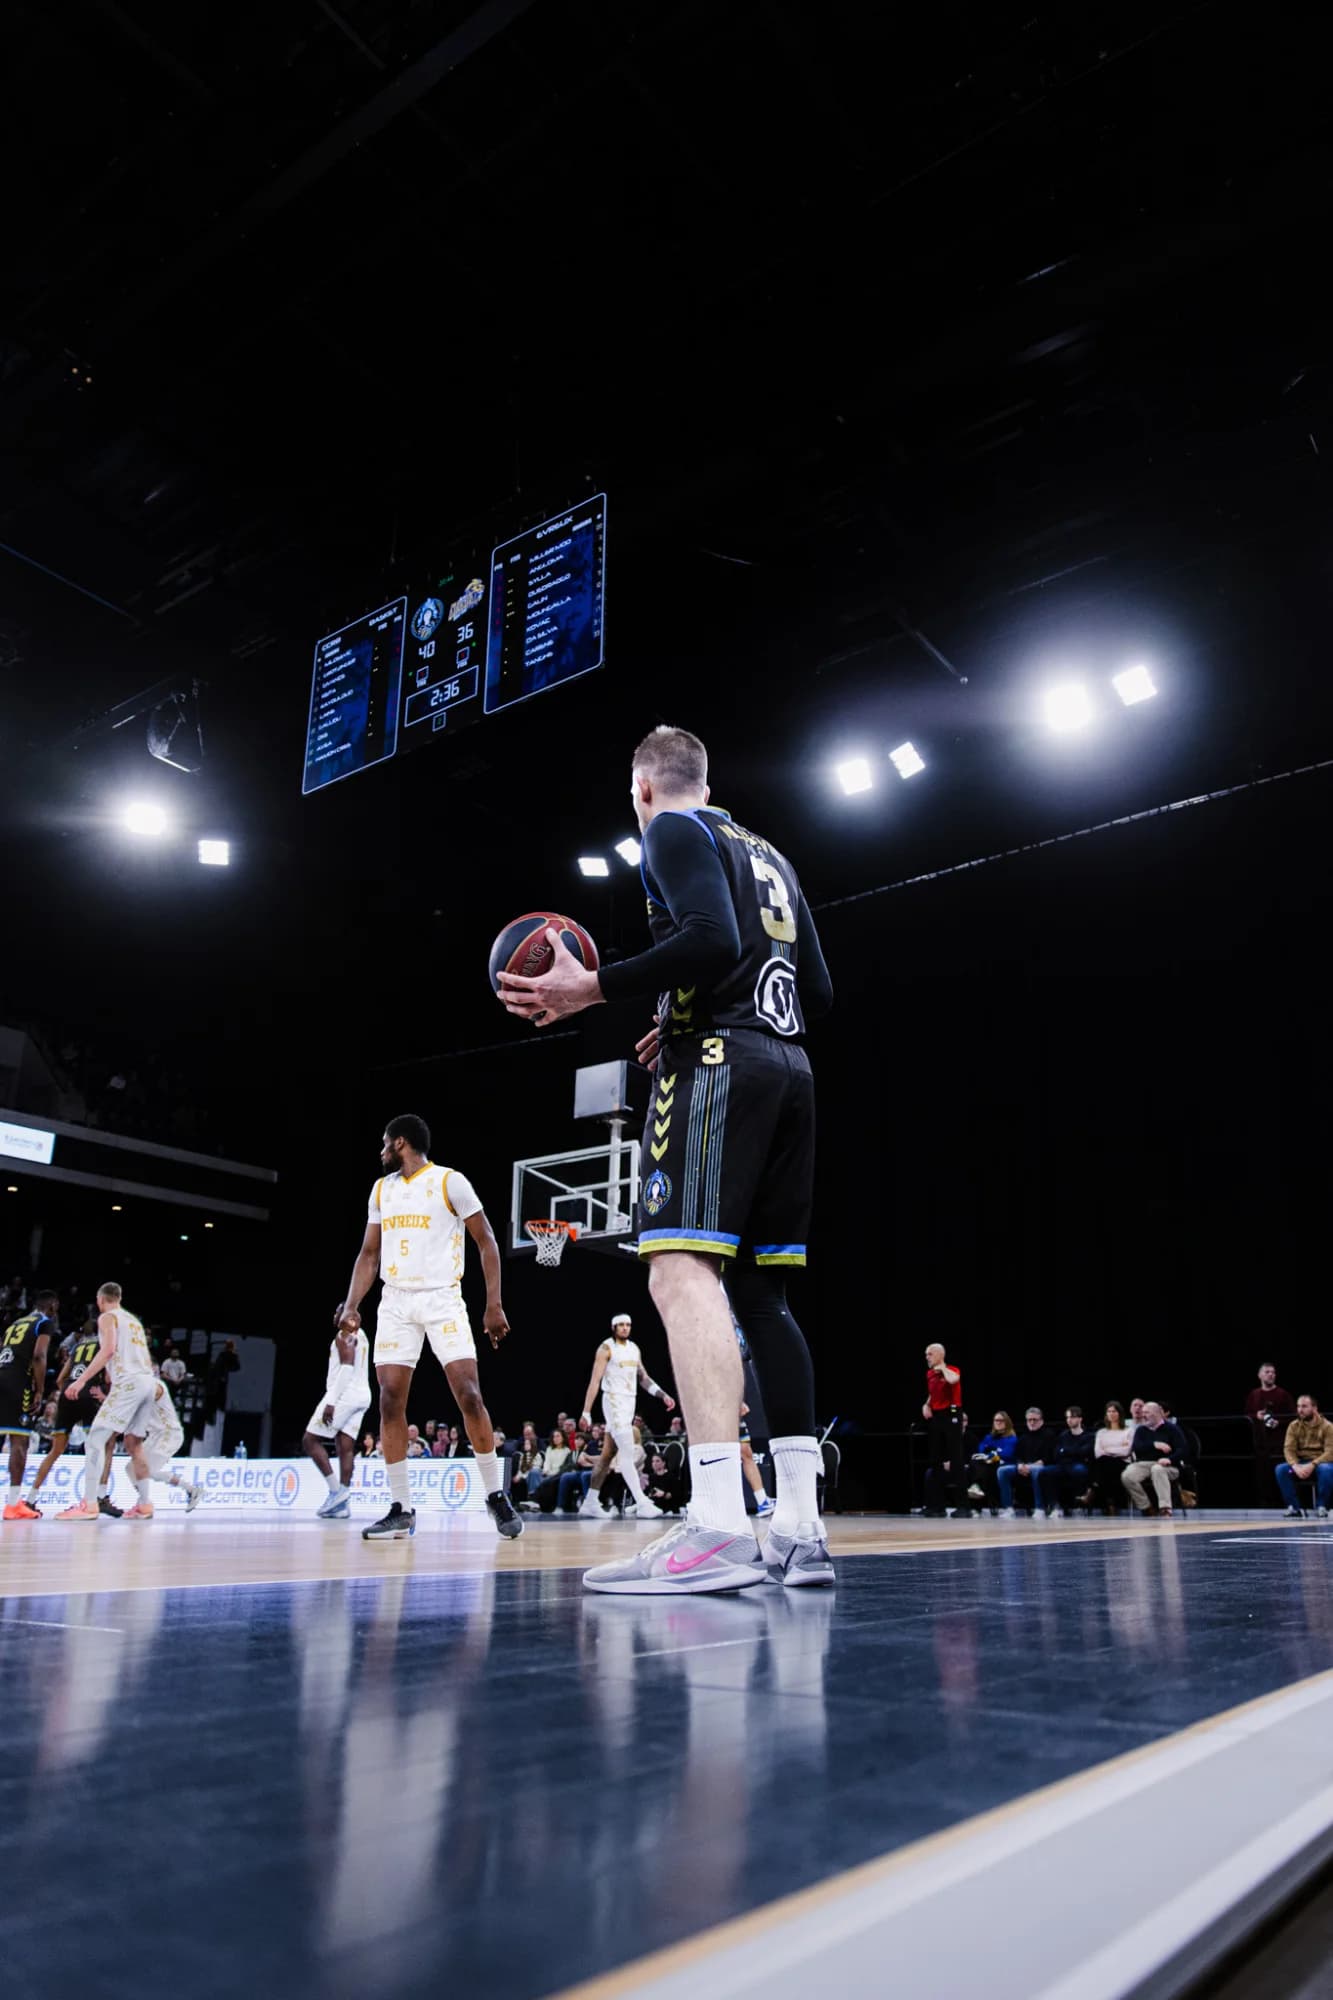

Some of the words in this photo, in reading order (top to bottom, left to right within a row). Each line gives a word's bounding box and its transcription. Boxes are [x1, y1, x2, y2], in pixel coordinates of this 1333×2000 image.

[456, 621, 474, 645] 36
[418, 639, 436, 659] 40
[430, 679, 460, 707] 2:36
[749, 854, 798, 945] 3
[702, 1037, 725, 1065] 3
[382, 1215, 432, 1233] EVREUX
[400, 1239, 411, 1257] 5
[3, 1322, 31, 1347] 13
[75, 1343, 97, 1363] 11
[171, 1465, 273, 1488] ELeclerc
